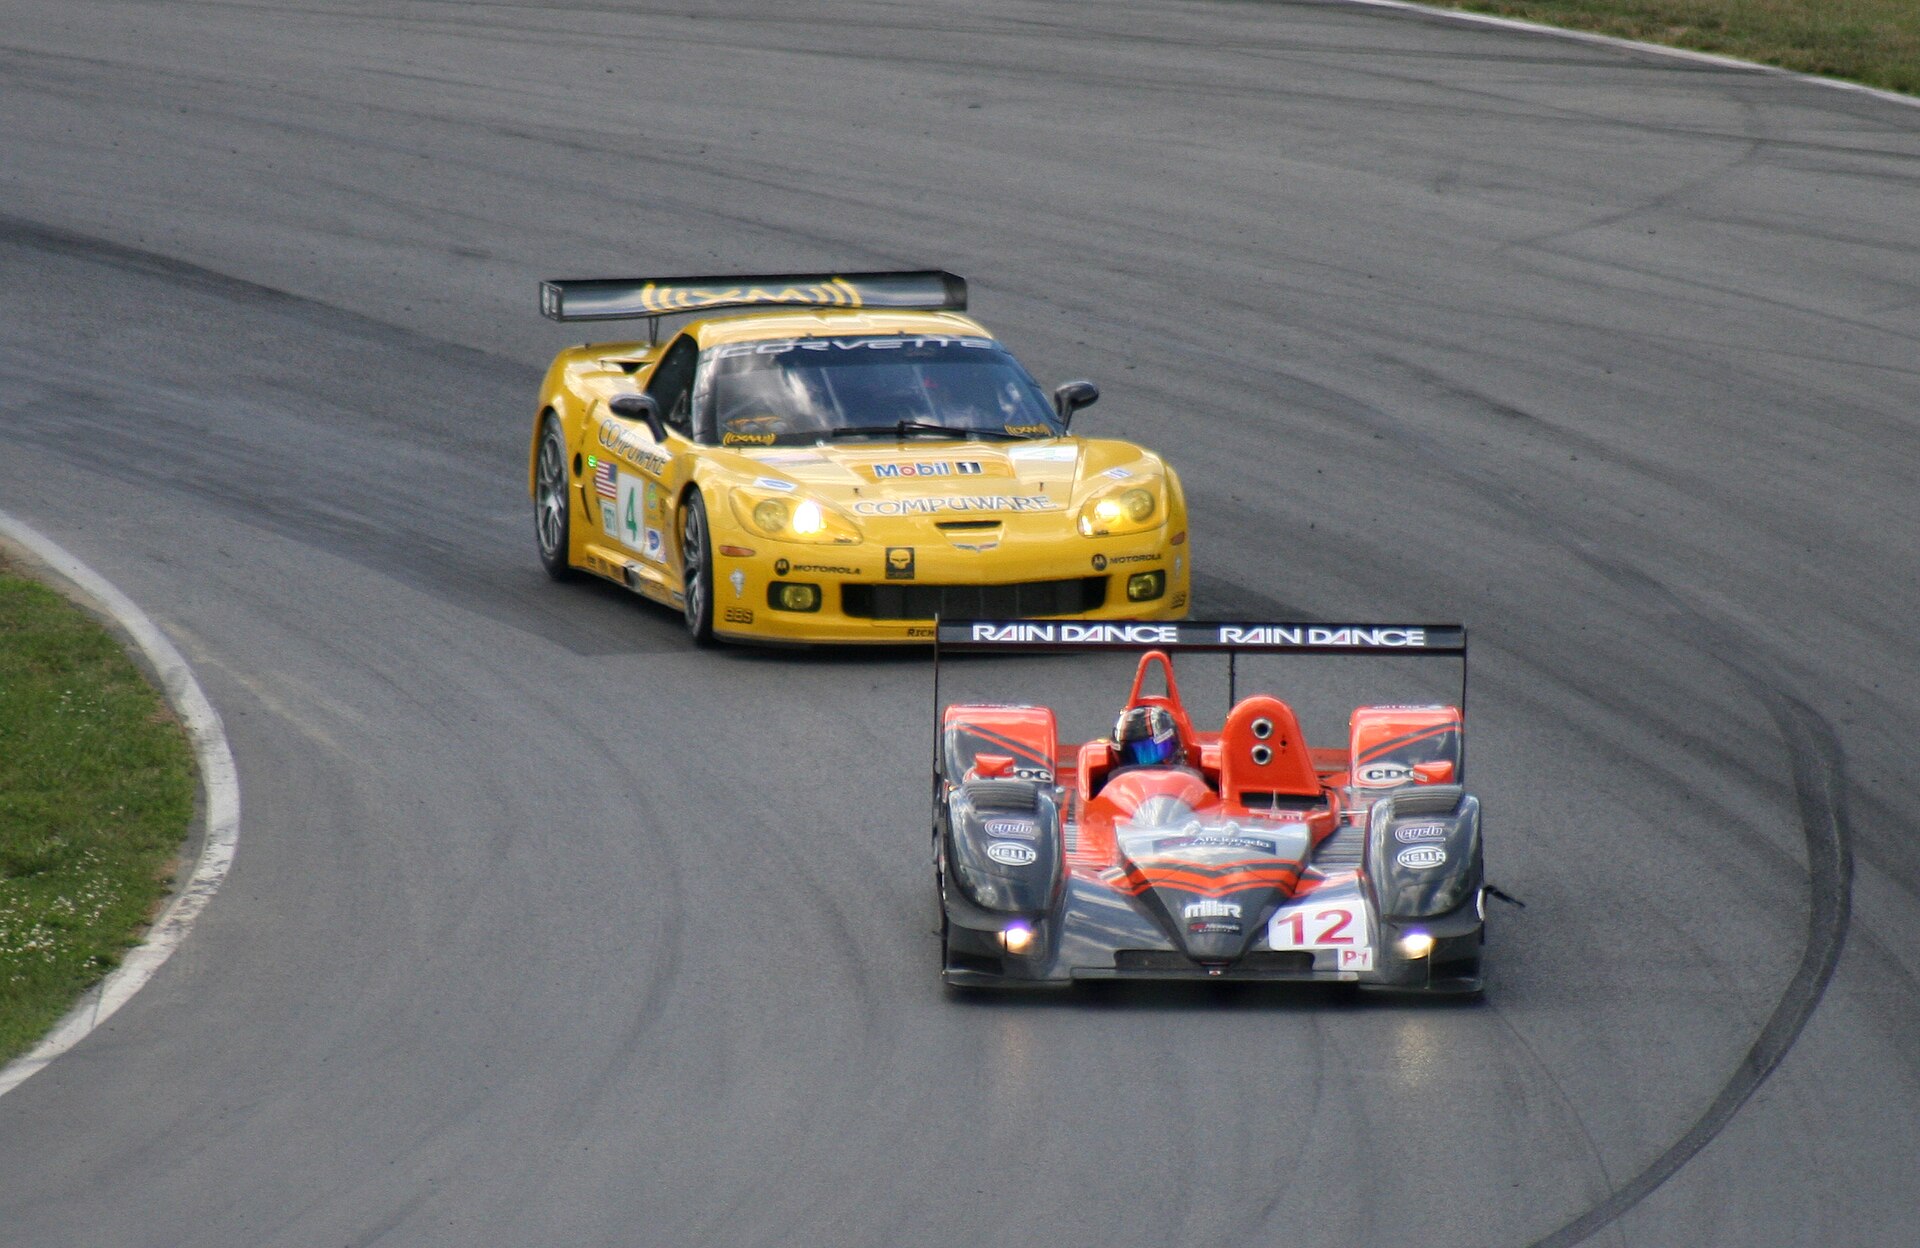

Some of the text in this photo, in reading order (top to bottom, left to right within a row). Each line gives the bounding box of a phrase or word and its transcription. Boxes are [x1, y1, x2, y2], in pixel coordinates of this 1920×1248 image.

[717, 338, 993, 358] CORVETTE
[873, 462, 977, 478] Mobil 1
[854, 495, 1057, 515] COMPUWARE
[625, 486, 638, 542] 4
[1109, 553, 1162, 564] MOTOROLA
[793, 564, 861, 575] MOTOROLA
[972, 624, 1179, 643] RAIN DANCE
[1218, 627, 1426, 647] RAIN DANCE
[1013, 769, 1053, 782] DC
[990, 847, 1036, 862] HELLA
[1401, 850, 1446, 863] HELLA
[1277, 909, 1354, 945] 12
[1343, 950, 1367, 967] P1
